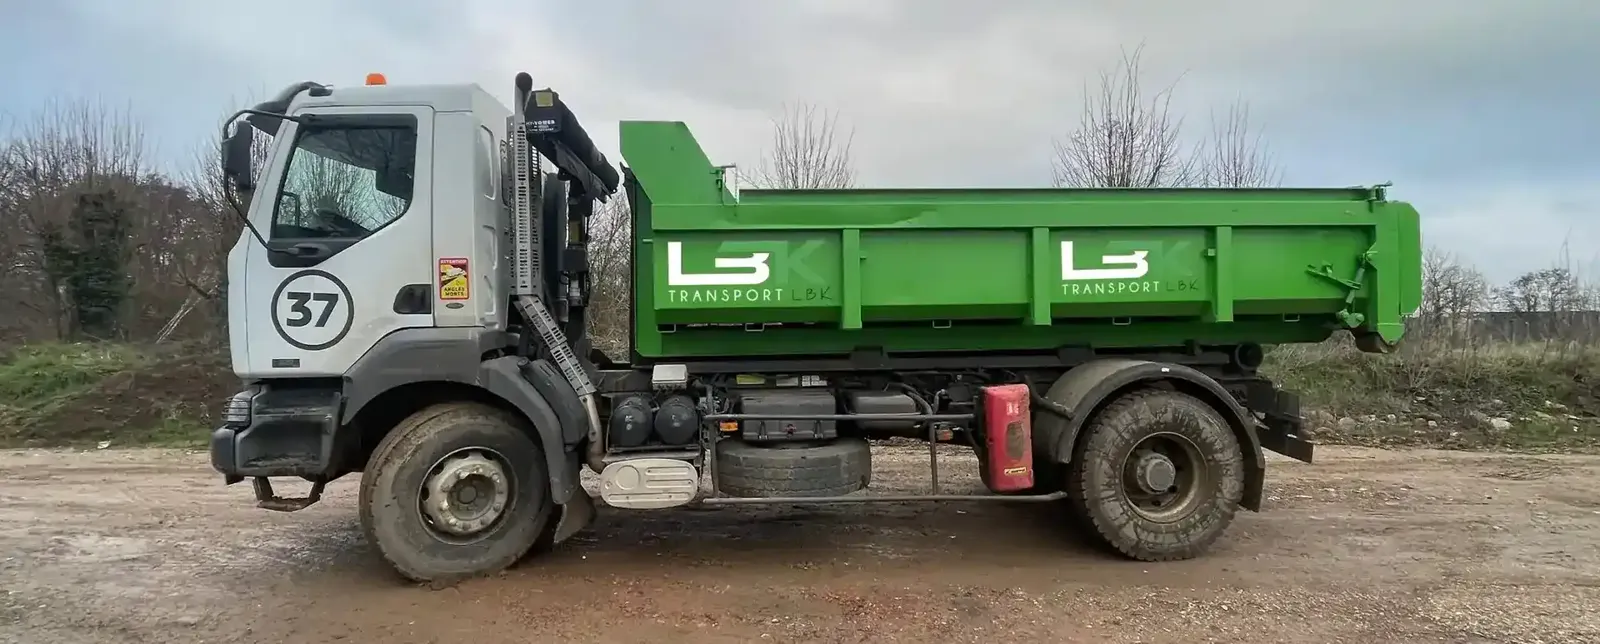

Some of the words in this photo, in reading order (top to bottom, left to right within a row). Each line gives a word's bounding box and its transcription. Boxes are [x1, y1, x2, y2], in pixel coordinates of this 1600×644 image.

[668, 288, 784, 302] TRANSPORT
[791, 286, 833, 301] LBK
[1061, 281, 1160, 295] TRANSPORT
[1165, 277, 1199, 292] LBK
[286, 291, 339, 328] 37
